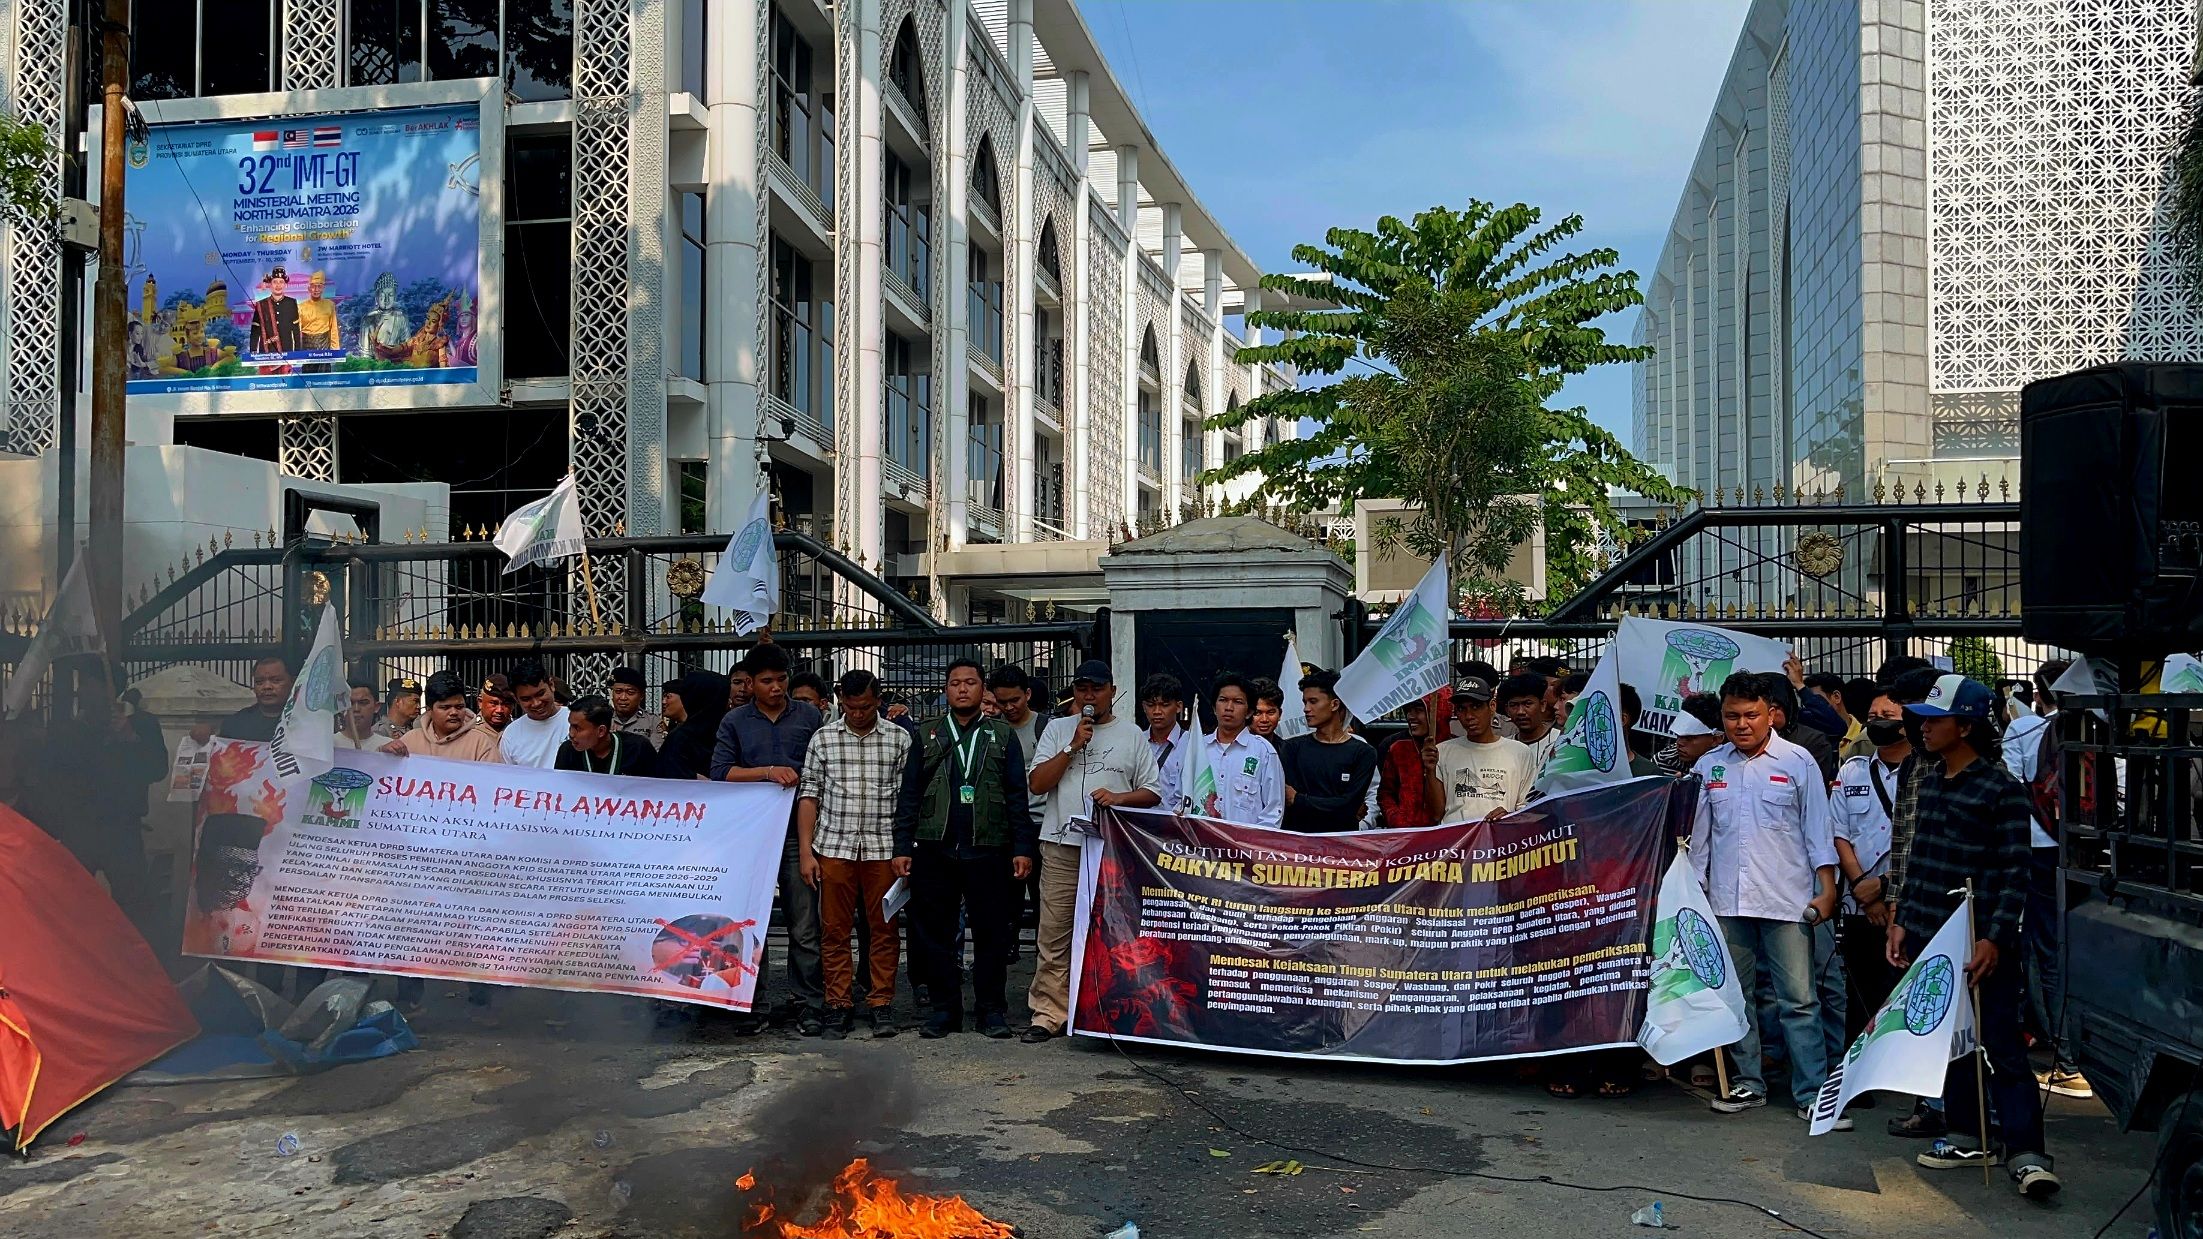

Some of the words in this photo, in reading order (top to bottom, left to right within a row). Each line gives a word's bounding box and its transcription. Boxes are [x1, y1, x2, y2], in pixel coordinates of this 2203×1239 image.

[239, 153, 291, 195] 32nd
[293, 152, 360, 190] IMT-GT
[234, 195, 305, 209] MINISTERIAL
[307, 192, 359, 205] MEETING
[234, 210, 273, 221] NORTH
[275, 206, 331, 219] SUMATRA
[333, 204, 359, 215] 2026
[246, 235, 258, 243] for
[259, 231, 307, 244] Regional
[293, 219, 359, 230] Collaboration
[270, 727, 300, 778] SUMUT
[375, 775, 477, 810] SUARA
[493, 786, 707, 827] PERLAWANAN
[302, 814, 360, 829] KAMMI
[367, 822, 437, 836] SUMATERA
[442, 828, 487, 840] UTARA
[371, 809, 438, 823] KESATUAN
[442, 817, 474, 826] AKSI
[477, 821, 559, 834] MAHASISWA
[563, 828, 615, 838] MUSLIM
[619, 831, 692, 842] INDONESIA
[289, 841, 322, 851] ULANG
[325, 846, 370, 857] SELURUH
[372, 852, 407, 861] PROSES
[410, 856, 461, 866] PEMILIHAN
[464, 860, 510, 870] ANGGOTA
[538, 866, 588, 875] SUMATERA
[293, 833, 346, 845] MENDESAK
[348, 840, 377, 848] KETUA
[406, 845, 458, 856] SUMATERA
[461, 851, 493, 860] UTARA
[518, 856, 551, 864] KOMISI
[590, 861, 641, 869] SUMATERA
[676, 865, 729, 873] MENINJAU
[1163, 843, 1211, 857] USUT
[1216, 848, 1287, 862] TUNTAS
[1294, 854, 1378, 868] DUGAAN
[1386, 848, 1465, 868] KORUPSI
[1472, 842, 1517, 859] DPRD
[1521, 824, 1576, 850] SUMUT
[282, 858, 339, 870] KELAYAKAN
[365, 869, 421, 880] KEPATUTAN
[424, 876, 450, 885] YANG
[452, 877, 506, 887] DILAKUKAN
[509, 883, 545, 891] SECARA
[548, 886, 596, 894] TERTUTUP
[598, 889, 646, 897] SEHINGGA
[649, 891, 722, 900] MENIMBULKAN
[1157, 852, 1245, 881] RAKYAT
[1252, 864, 1379, 888] SUMATERA
[1388, 861, 1463, 884] UTARA
[1472, 838, 1578, 883] MENUNTUT
[279, 867, 335, 879] PERSOALAN
[339, 874, 411, 888] TRANSPARANSI
[413, 883, 434, 892] DAN
[436, 885, 511, 897] AKUNTABILITAS
[513, 892, 547, 900] DALAM
[274, 885, 326, 895] MENDESAK
[328, 891, 358, 900] KETUA
[390, 898, 442, 909] SUMATERA
[444, 904, 476, 913] UTARA
[502, 909, 536, 917] KOMISI
[575, 915, 624, 923] SUMATERA
[1142, 886, 1184, 899] Meminta
[1188, 893, 1209, 904] KPK
[1211, 898, 1222, 906] RI
[1225, 900, 1256, 911] turun
[1260, 904, 1314, 916] langsung
[1335, 903, 1390, 914] Sumatera
[1394, 904, 1425, 916] Utara
[1428, 907, 1463, 917] untuk
[1466, 900, 1524, 917] melakukan
[1139, 929, 1175, 939] peraturan
[1178, 932, 1272, 948] perundang-undangan.
[1141, 919, 1180, 929] berpotensi
[1183, 922, 1209, 931] terjadi
[1411, 940, 1448, 949] maupun
[1451, 938, 1483, 949] praktik
[1486, 937, 1506, 946] yang
[1510, 932, 1528, 944] tidak
[1530, 926, 1556, 938] sesuai
[1559, 920, 1590, 933] dengan
[1596, 909, 1636, 926] ketentuan
[1209, 954, 1270, 968] Mendesak
[1273, 960, 1336, 974] Kejaksaan
[1340, 965, 1376, 978] Tinggi
[1380, 968, 1438, 980] Sumatera
[1442, 970, 1472, 980] Utara
[1476, 966, 1508, 978] untuk
[1511, 957, 1570, 975] melakukan
[1573, 942, 1646, 966] pemeriksaan
[1209, 967, 1248, 978] terhadap
[1252, 971, 1309, 982] penggunaan
[1315, 976, 1359, 986] anggaran
[1474, 981, 1497, 989] Pokir
[1501, 976, 1533, 986] seluruh
[1538, 970, 1570, 982] Anggota
[1574, 964, 1593, 975] DPRD
[1596, 957, 1641, 969] Sumatera
